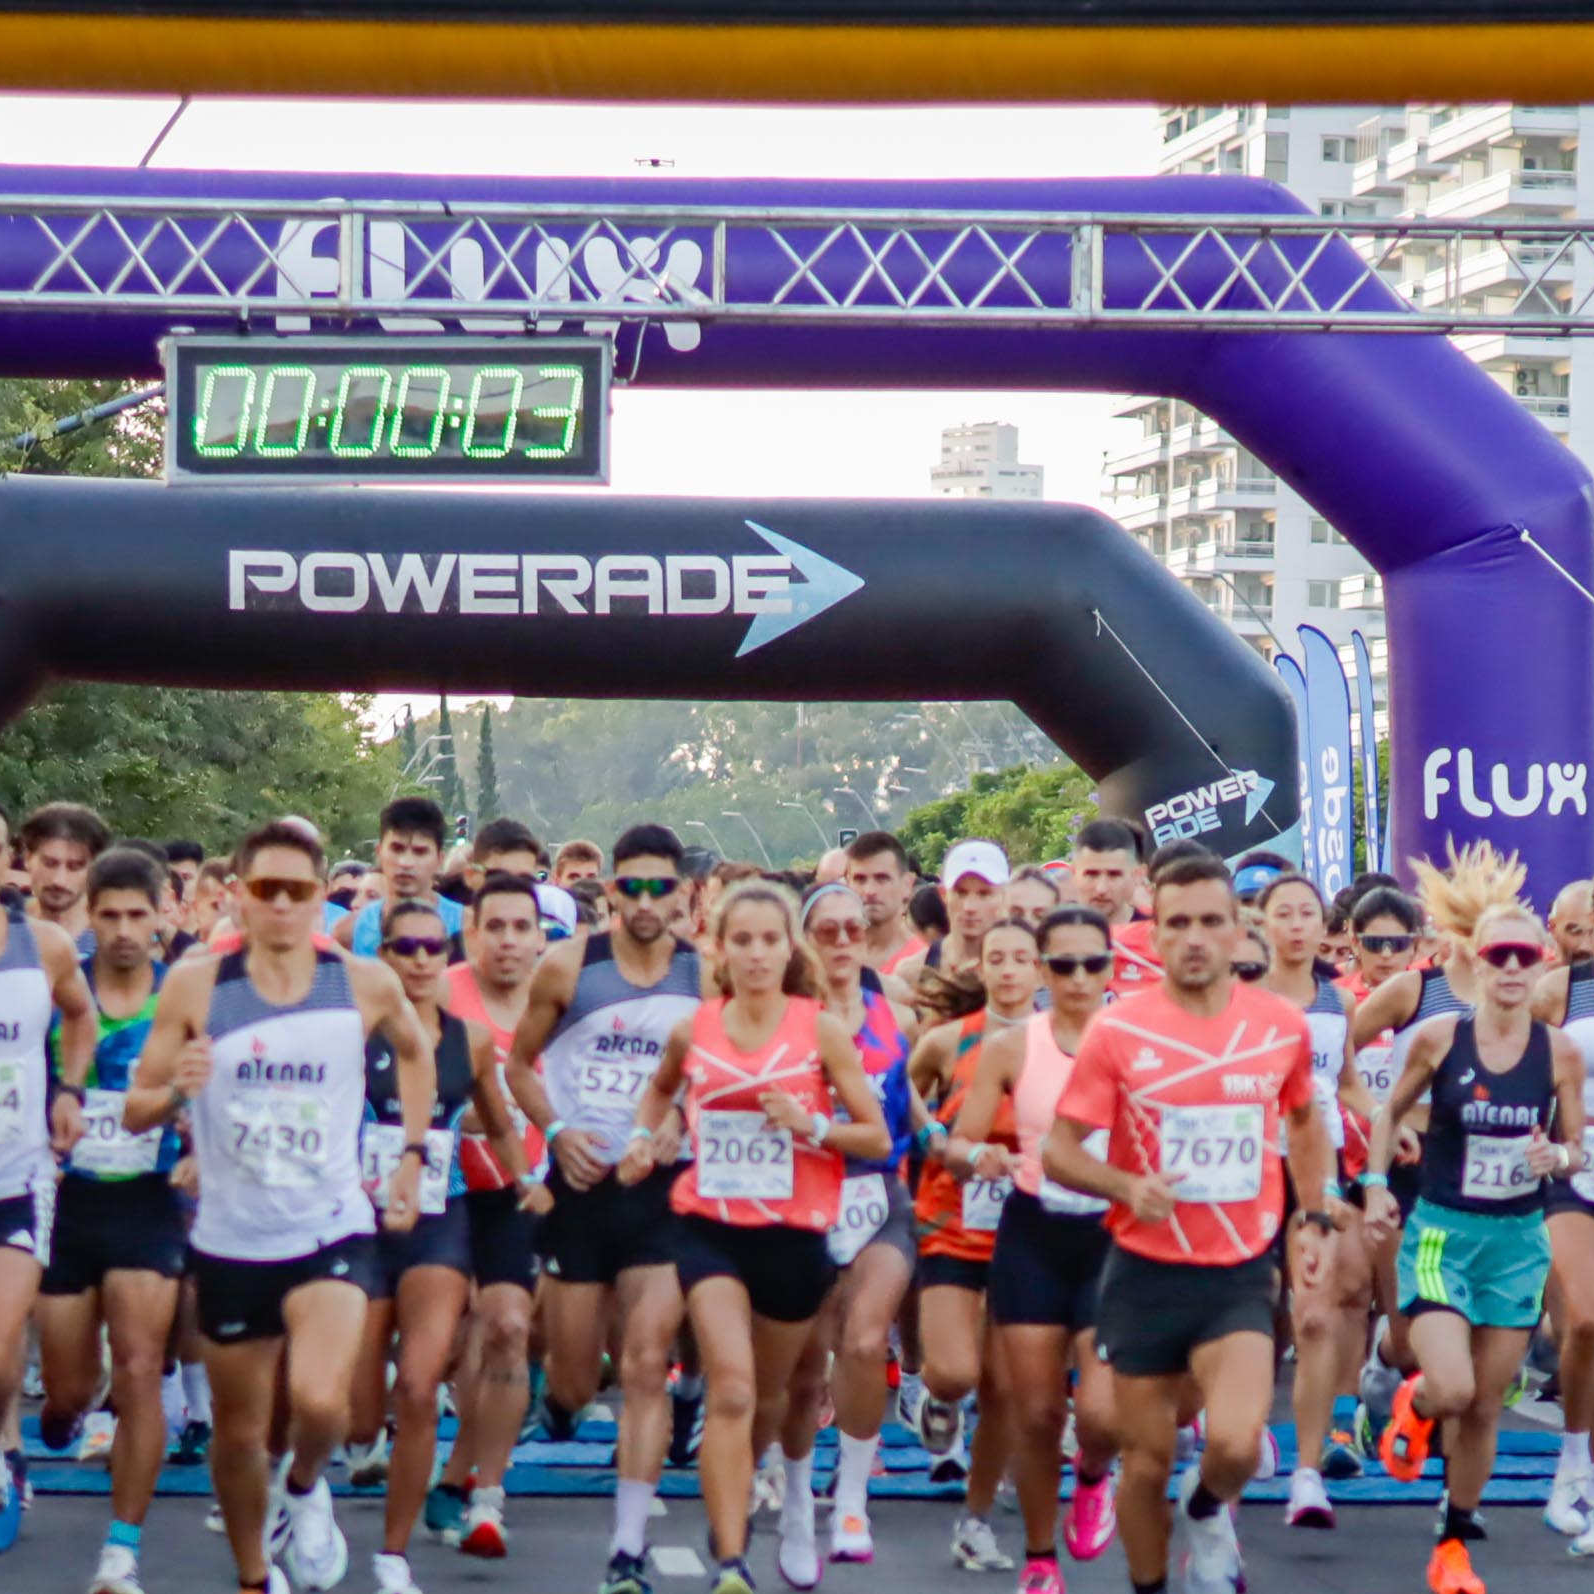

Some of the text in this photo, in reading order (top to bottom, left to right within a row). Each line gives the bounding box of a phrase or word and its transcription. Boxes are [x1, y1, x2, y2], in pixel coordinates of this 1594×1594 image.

[229, 549, 793, 615] POWERADE
[1145, 769, 1259, 831] POWER
[1153, 806, 1223, 848] ADE
[236, 1058, 326, 1084] ATENAS
[584, 1067, 654, 1095] 527
[1461, 1101, 1539, 1126] ATENAS
[232, 1121, 322, 1153] 7430
[704, 1138, 789, 1165] 2062
[1167, 1137, 1258, 1167] 7670
